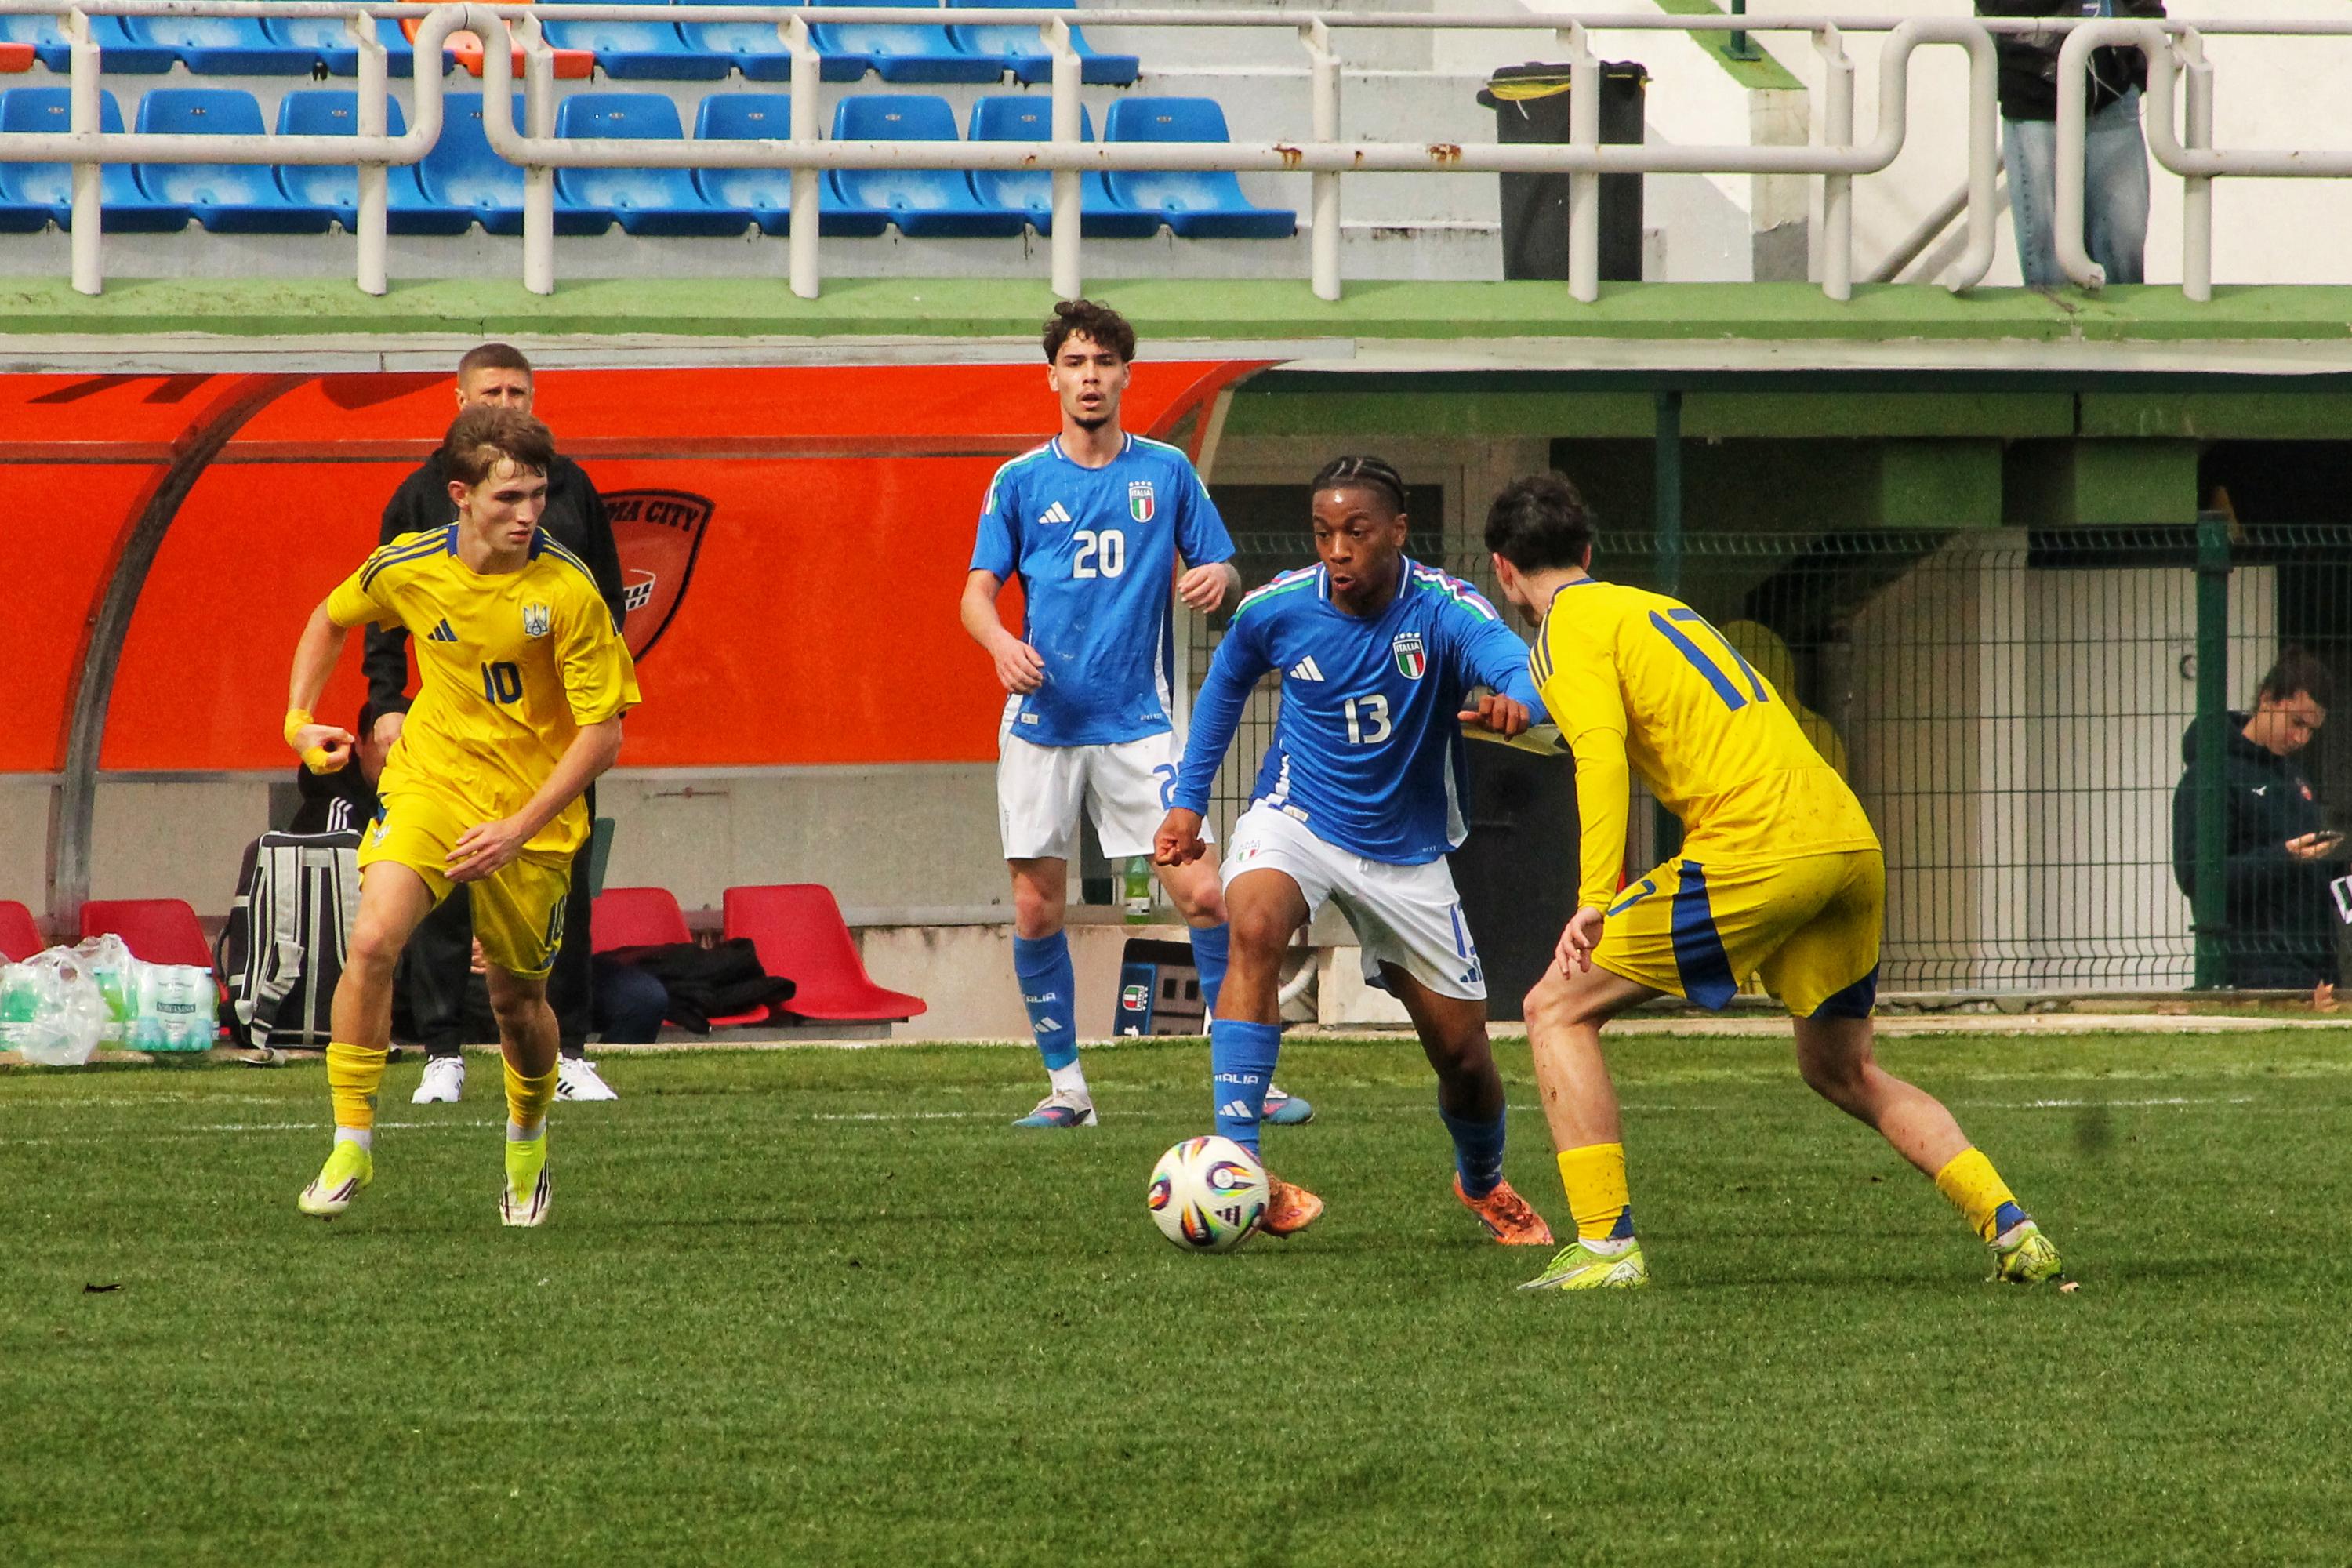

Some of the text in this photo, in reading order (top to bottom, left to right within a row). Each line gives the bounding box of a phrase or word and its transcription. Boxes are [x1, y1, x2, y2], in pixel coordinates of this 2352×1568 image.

[1131, 488, 1152, 497] ITALIA
[604, 500, 699, 532] MA CITY
[1073, 529, 1124, 579] 20
[1396, 641, 1421, 653] ITALIA
[1648, 608, 1769, 712] 17
[481, 661, 523, 704] 10
[1345, 694, 1392, 744] 13
[1152, 763, 1178, 811] 2
[1450, 902, 1475, 959] 1
[1022, 992, 1056, 1003] ALIA
